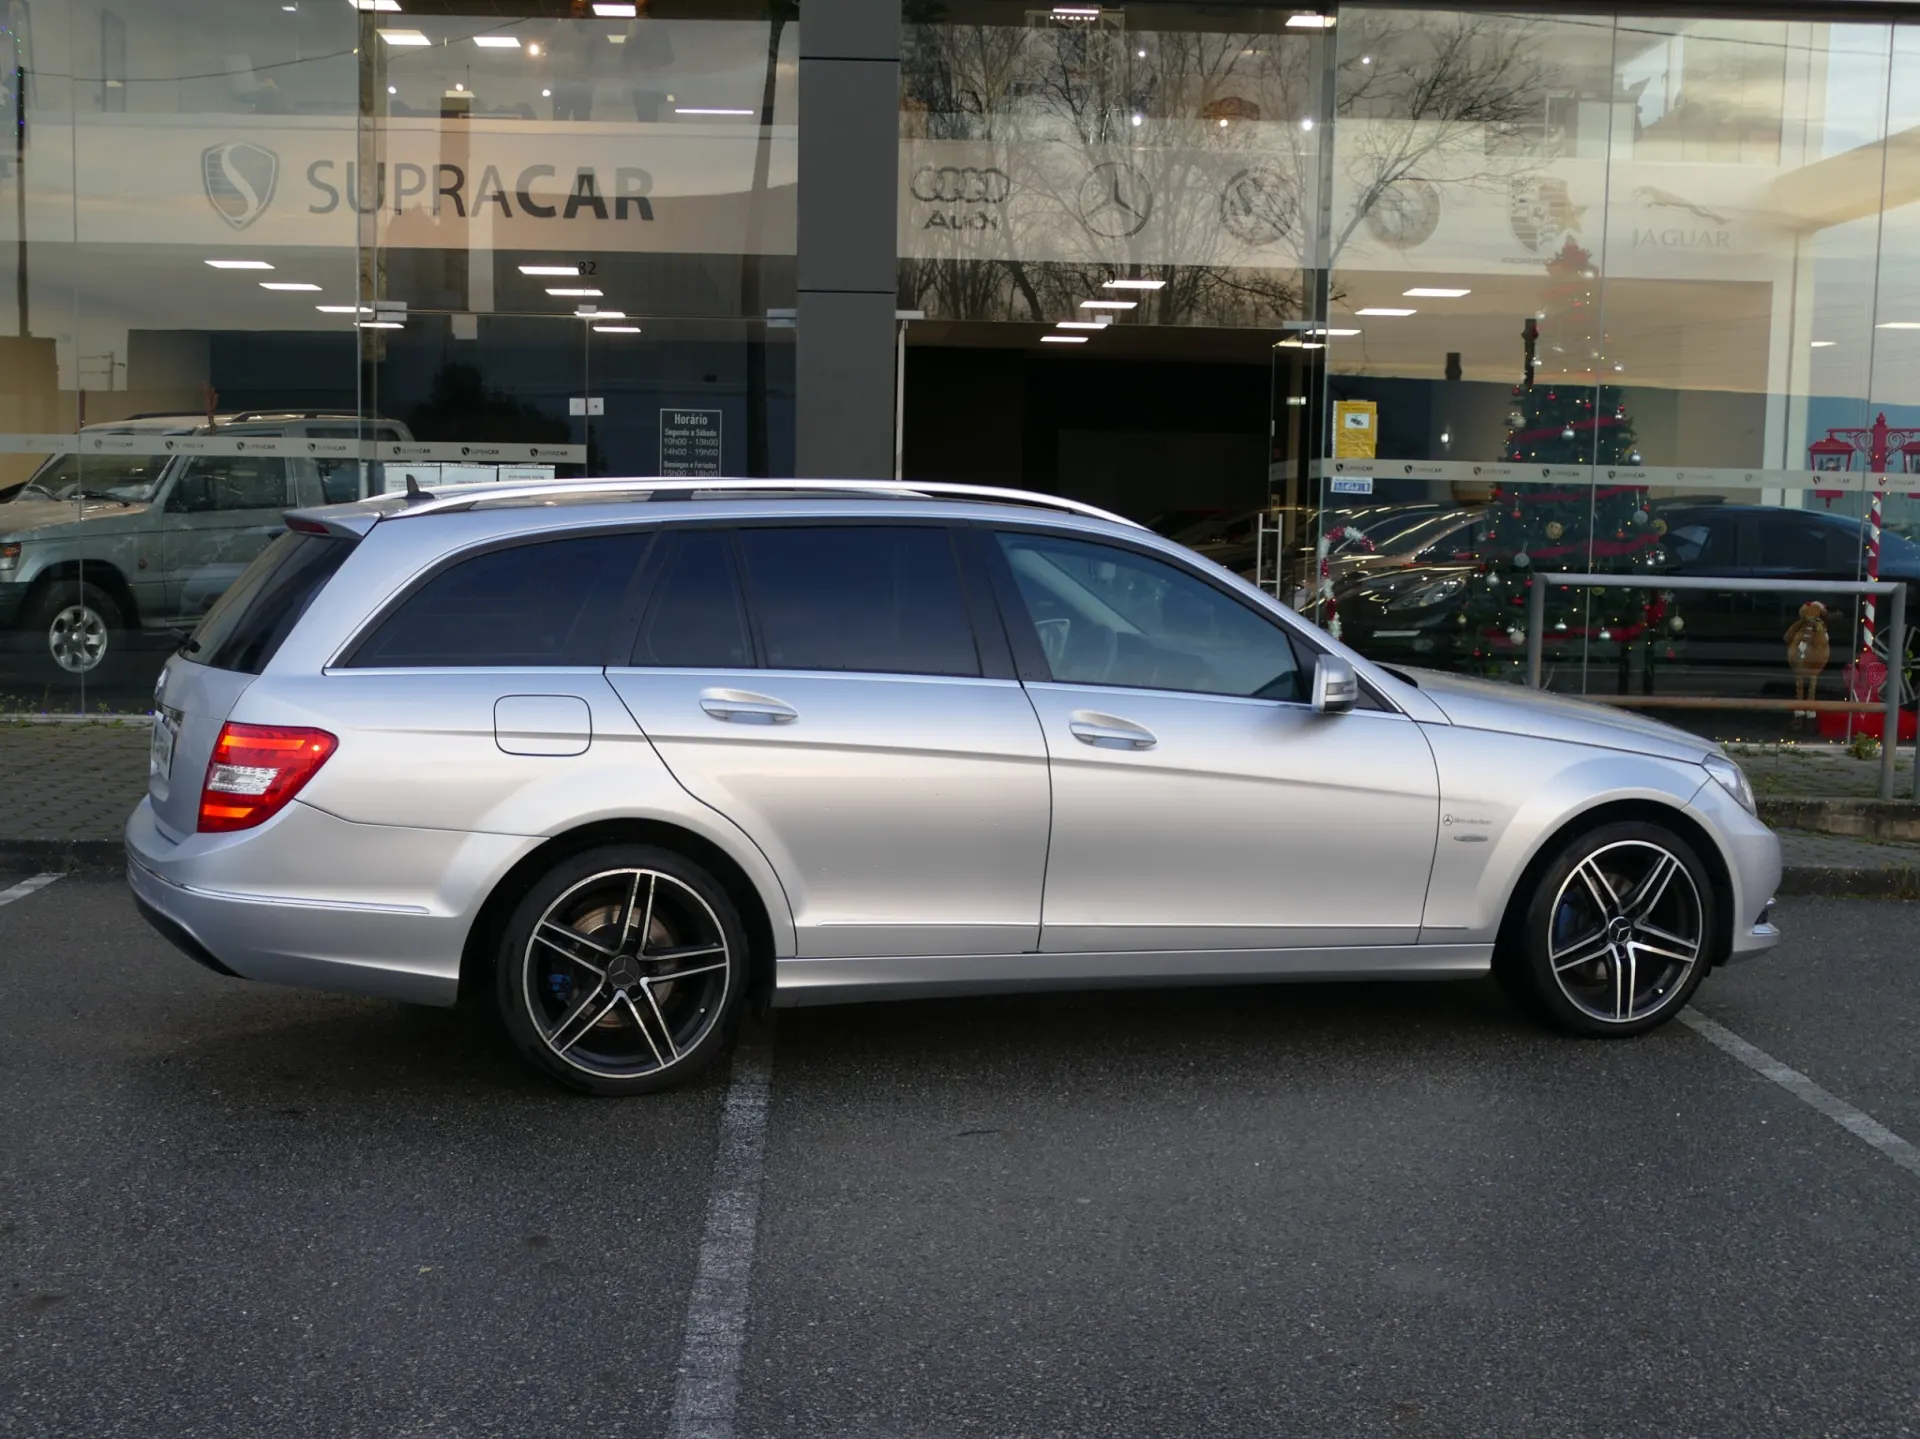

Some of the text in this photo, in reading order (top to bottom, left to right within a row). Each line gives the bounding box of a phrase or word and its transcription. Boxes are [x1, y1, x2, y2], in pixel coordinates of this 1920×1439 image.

[306, 160, 654, 221] SUPRACAR
[1632, 228, 1731, 249] JAGUAR
[578, 260, 597, 276] 82
[674, 413, 708, 425] Horário
